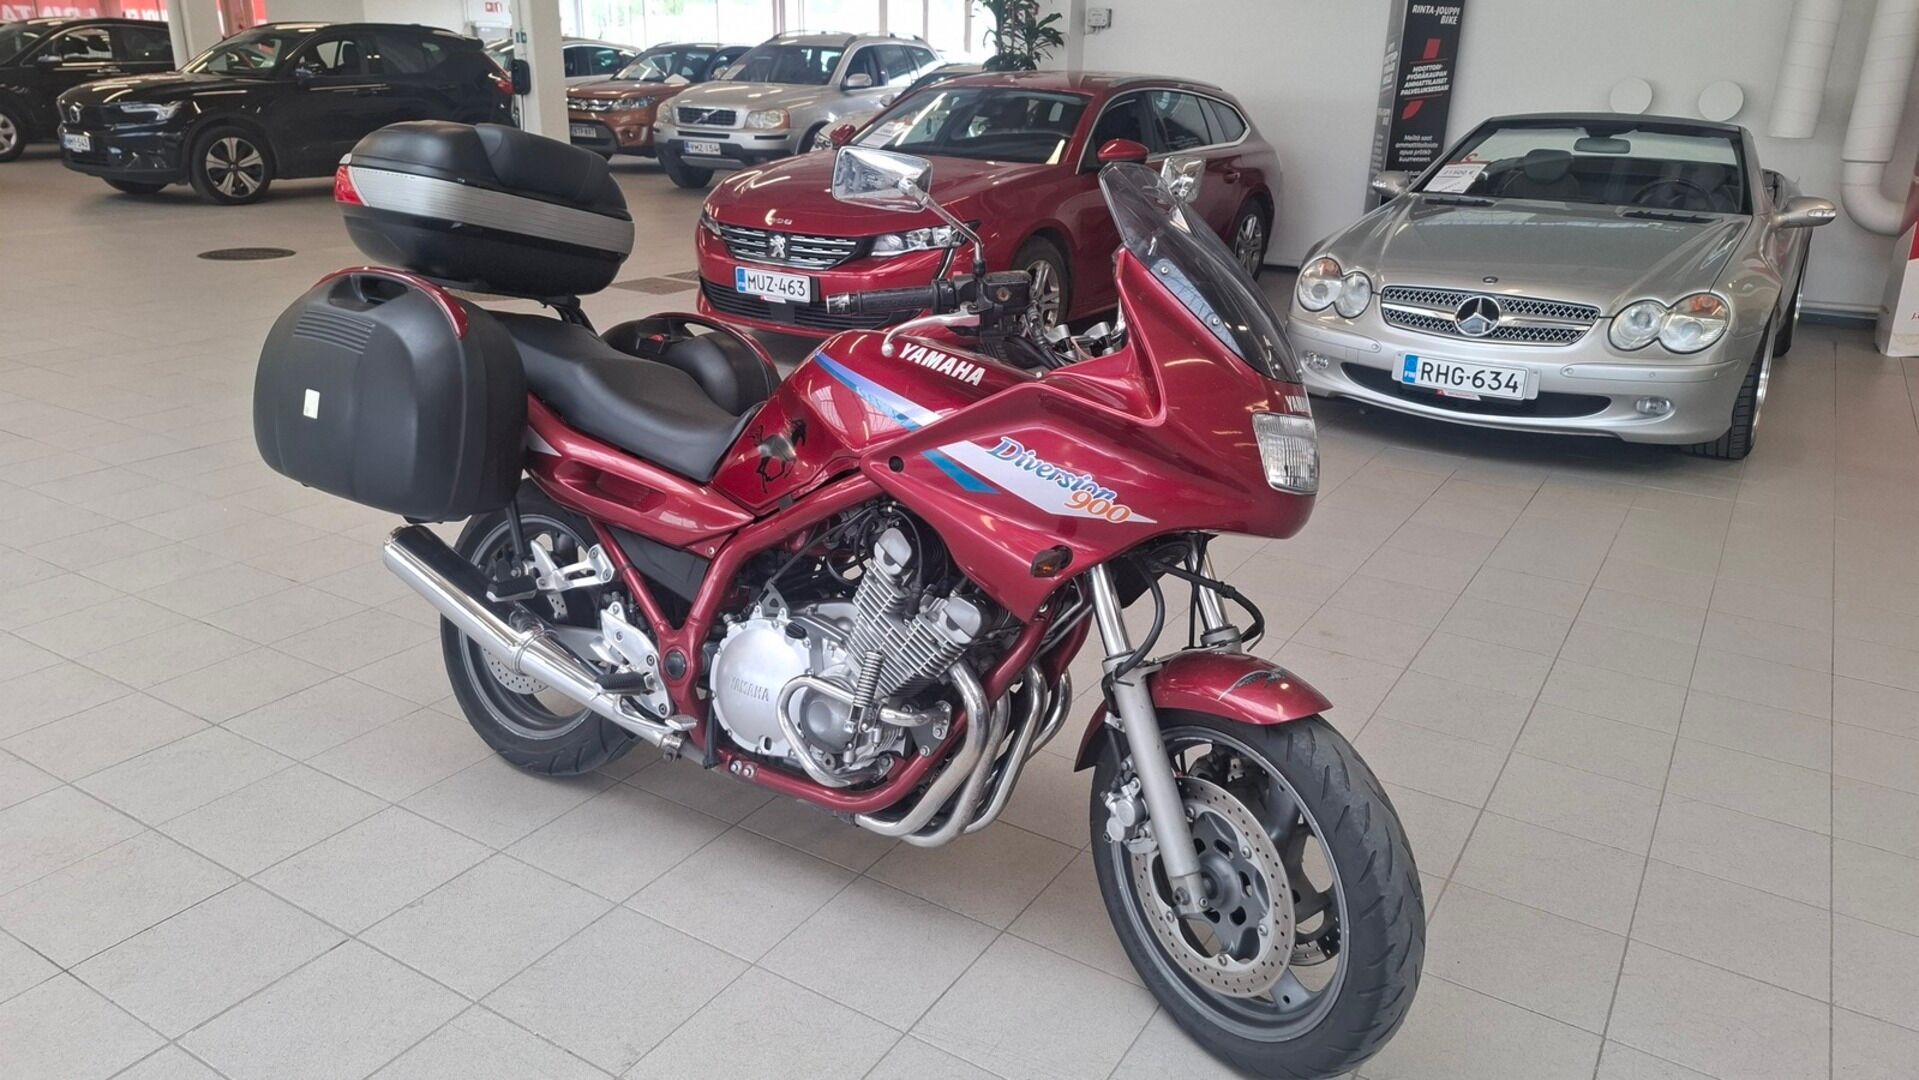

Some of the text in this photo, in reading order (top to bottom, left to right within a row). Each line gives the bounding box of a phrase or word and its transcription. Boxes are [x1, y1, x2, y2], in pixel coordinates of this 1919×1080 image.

[1412, 4, 1460, 16] RINTA-JOUPPI
[1440, 15, 1458, 25] BIKE
[748, 273, 806, 297] MUZ-463
[899, 342, 986, 387] YAMAHA
[1420, 361, 1519, 394] RHG-634
[985, 437, 1117, 500] Diversion
[1064, 490, 1132, 523] 900
[730, 676, 769, 702] YAMAHA
